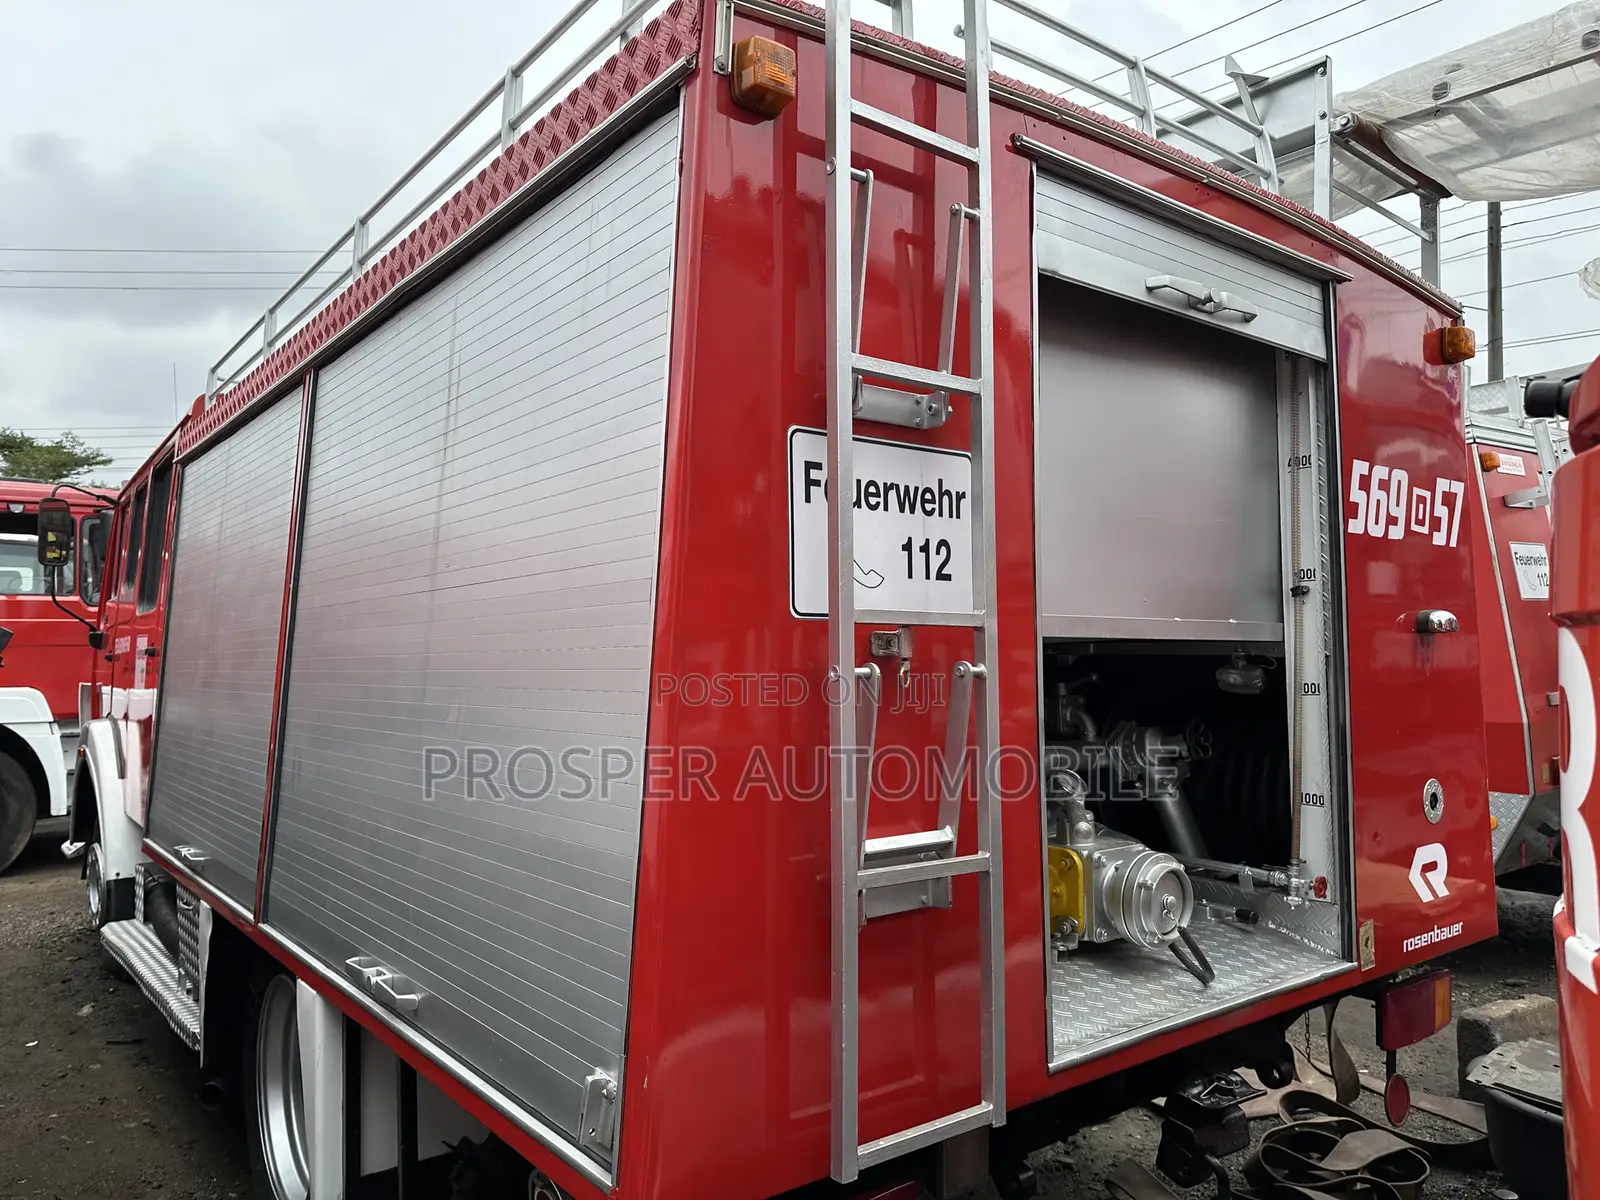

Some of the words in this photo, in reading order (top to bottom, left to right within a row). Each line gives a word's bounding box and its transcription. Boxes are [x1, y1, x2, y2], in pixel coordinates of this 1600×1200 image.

[901, 537, 952, 582] 112
[1537, 572, 1550, 587] 112
[1403, 921, 1464, 954] rosenbauer
